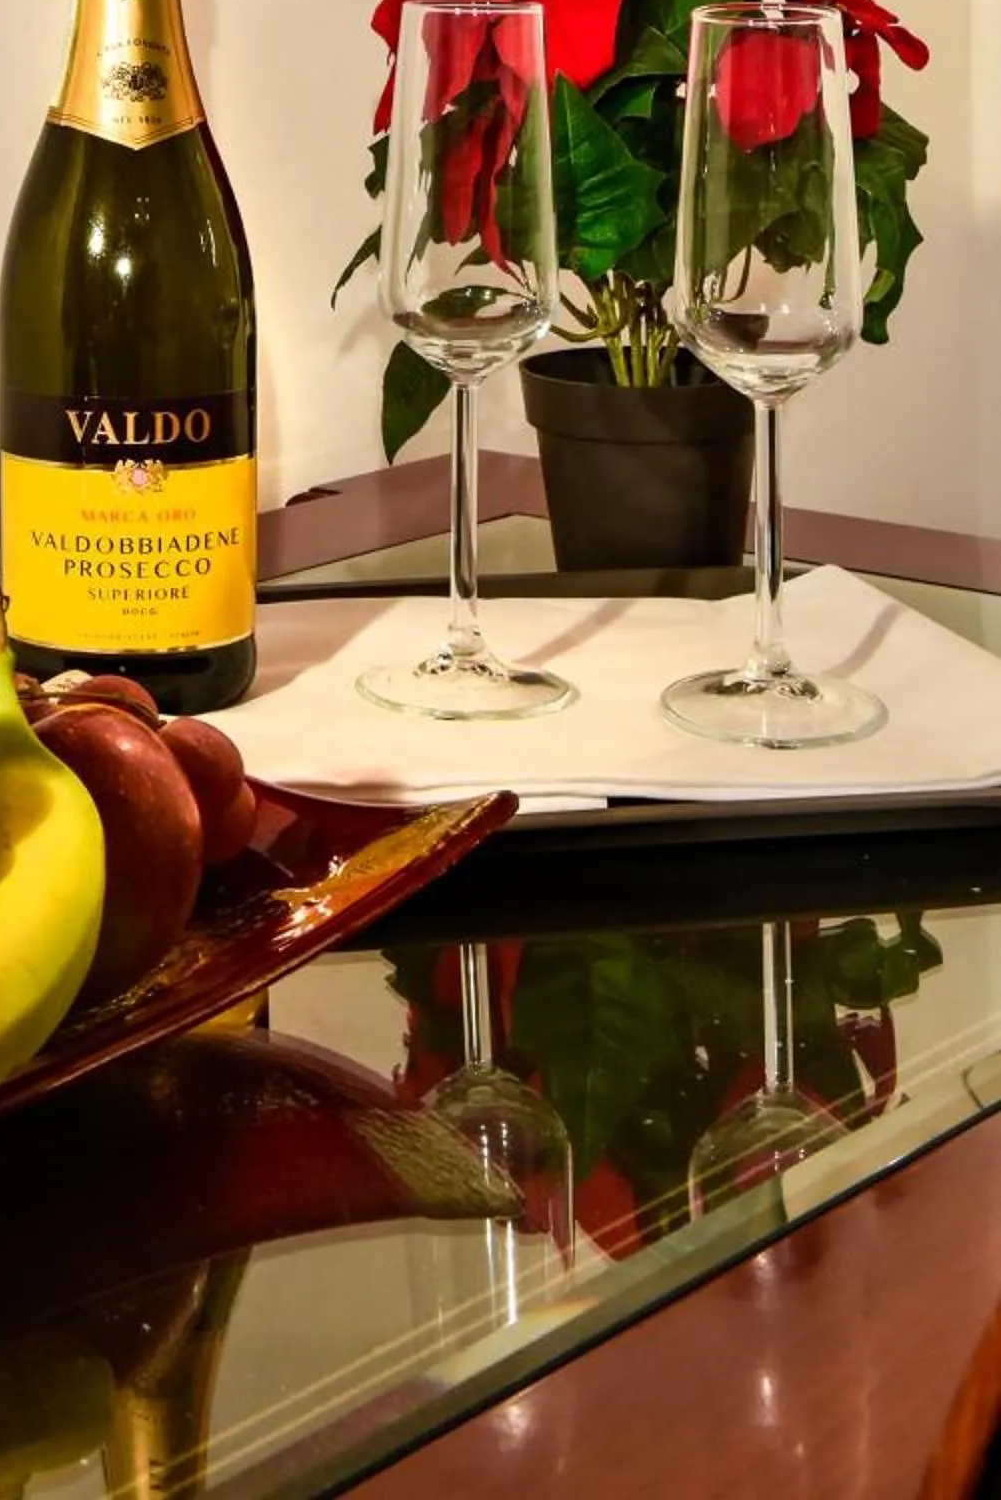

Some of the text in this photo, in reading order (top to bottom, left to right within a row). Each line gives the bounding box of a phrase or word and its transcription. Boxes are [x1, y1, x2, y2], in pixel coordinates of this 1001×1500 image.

[65, 409, 211, 445] VALDO
[82, 509, 197, 523] MARCA ORO
[31, 528, 240, 555] VALDOBBIADENE
[65, 558, 212, 579] PROSECCO
[87, 586, 190, 601] SUPERIORE
